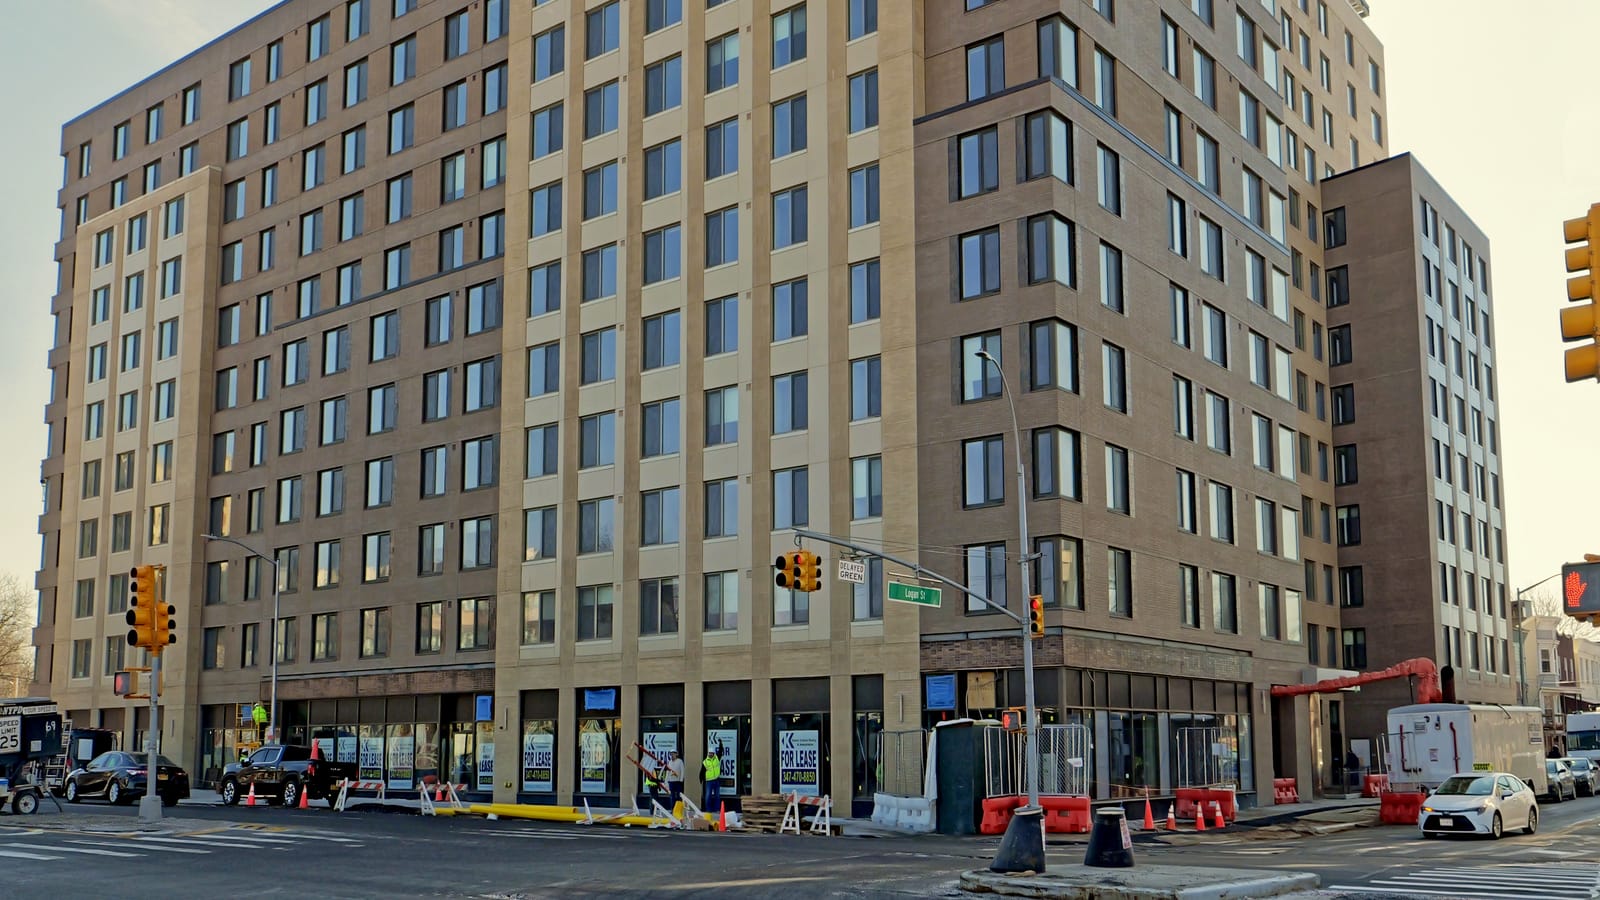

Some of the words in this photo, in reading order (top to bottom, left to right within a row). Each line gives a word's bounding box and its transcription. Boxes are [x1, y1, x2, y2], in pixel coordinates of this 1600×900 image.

[840, 562, 864, 573] DELAYED
[840, 571, 863, 581] GREEN
[905, 588, 919, 600] Logan
[920, 590, 926, 600] St
[3, 706, 23, 715] NYPD
[45, 721, 56, 731] 69
[0, 735, 18, 749] 25
[525, 752, 535, 767] FOR
[536, 752, 551, 767] LEASE
[781, 750, 794, 767] FOR
[796, 750, 816, 767] LEASE
[480, 760, 493, 772] LEASE
